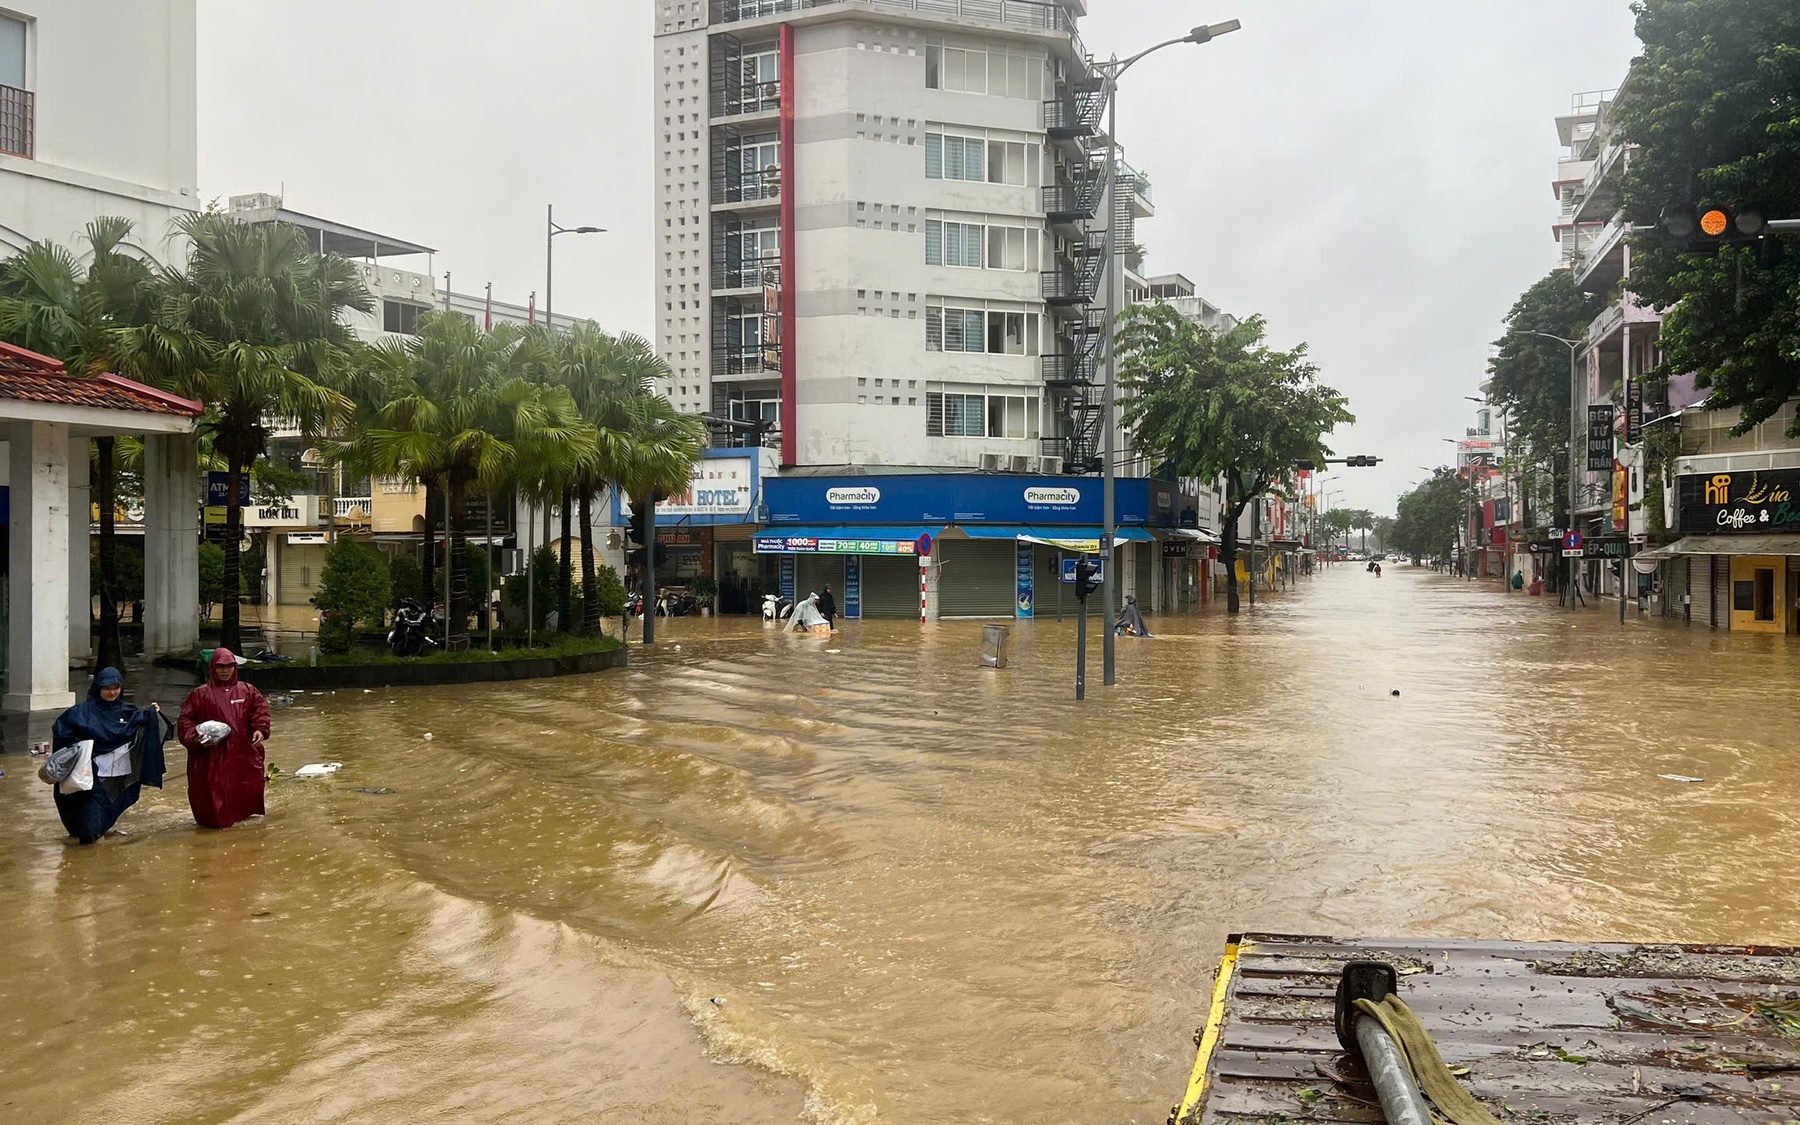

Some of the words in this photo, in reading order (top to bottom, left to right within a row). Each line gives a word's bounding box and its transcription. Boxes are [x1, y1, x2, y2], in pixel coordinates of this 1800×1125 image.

[697, 490, 739, 506] HOTEL
[830, 490, 876, 502] Pharmacity
[1027, 490, 1076, 502] Pharmacity
[1716, 508, 1756, 529] Coffee
[1759, 509, 1769, 522] &
[1163, 545, 1186, 553] OWEN
